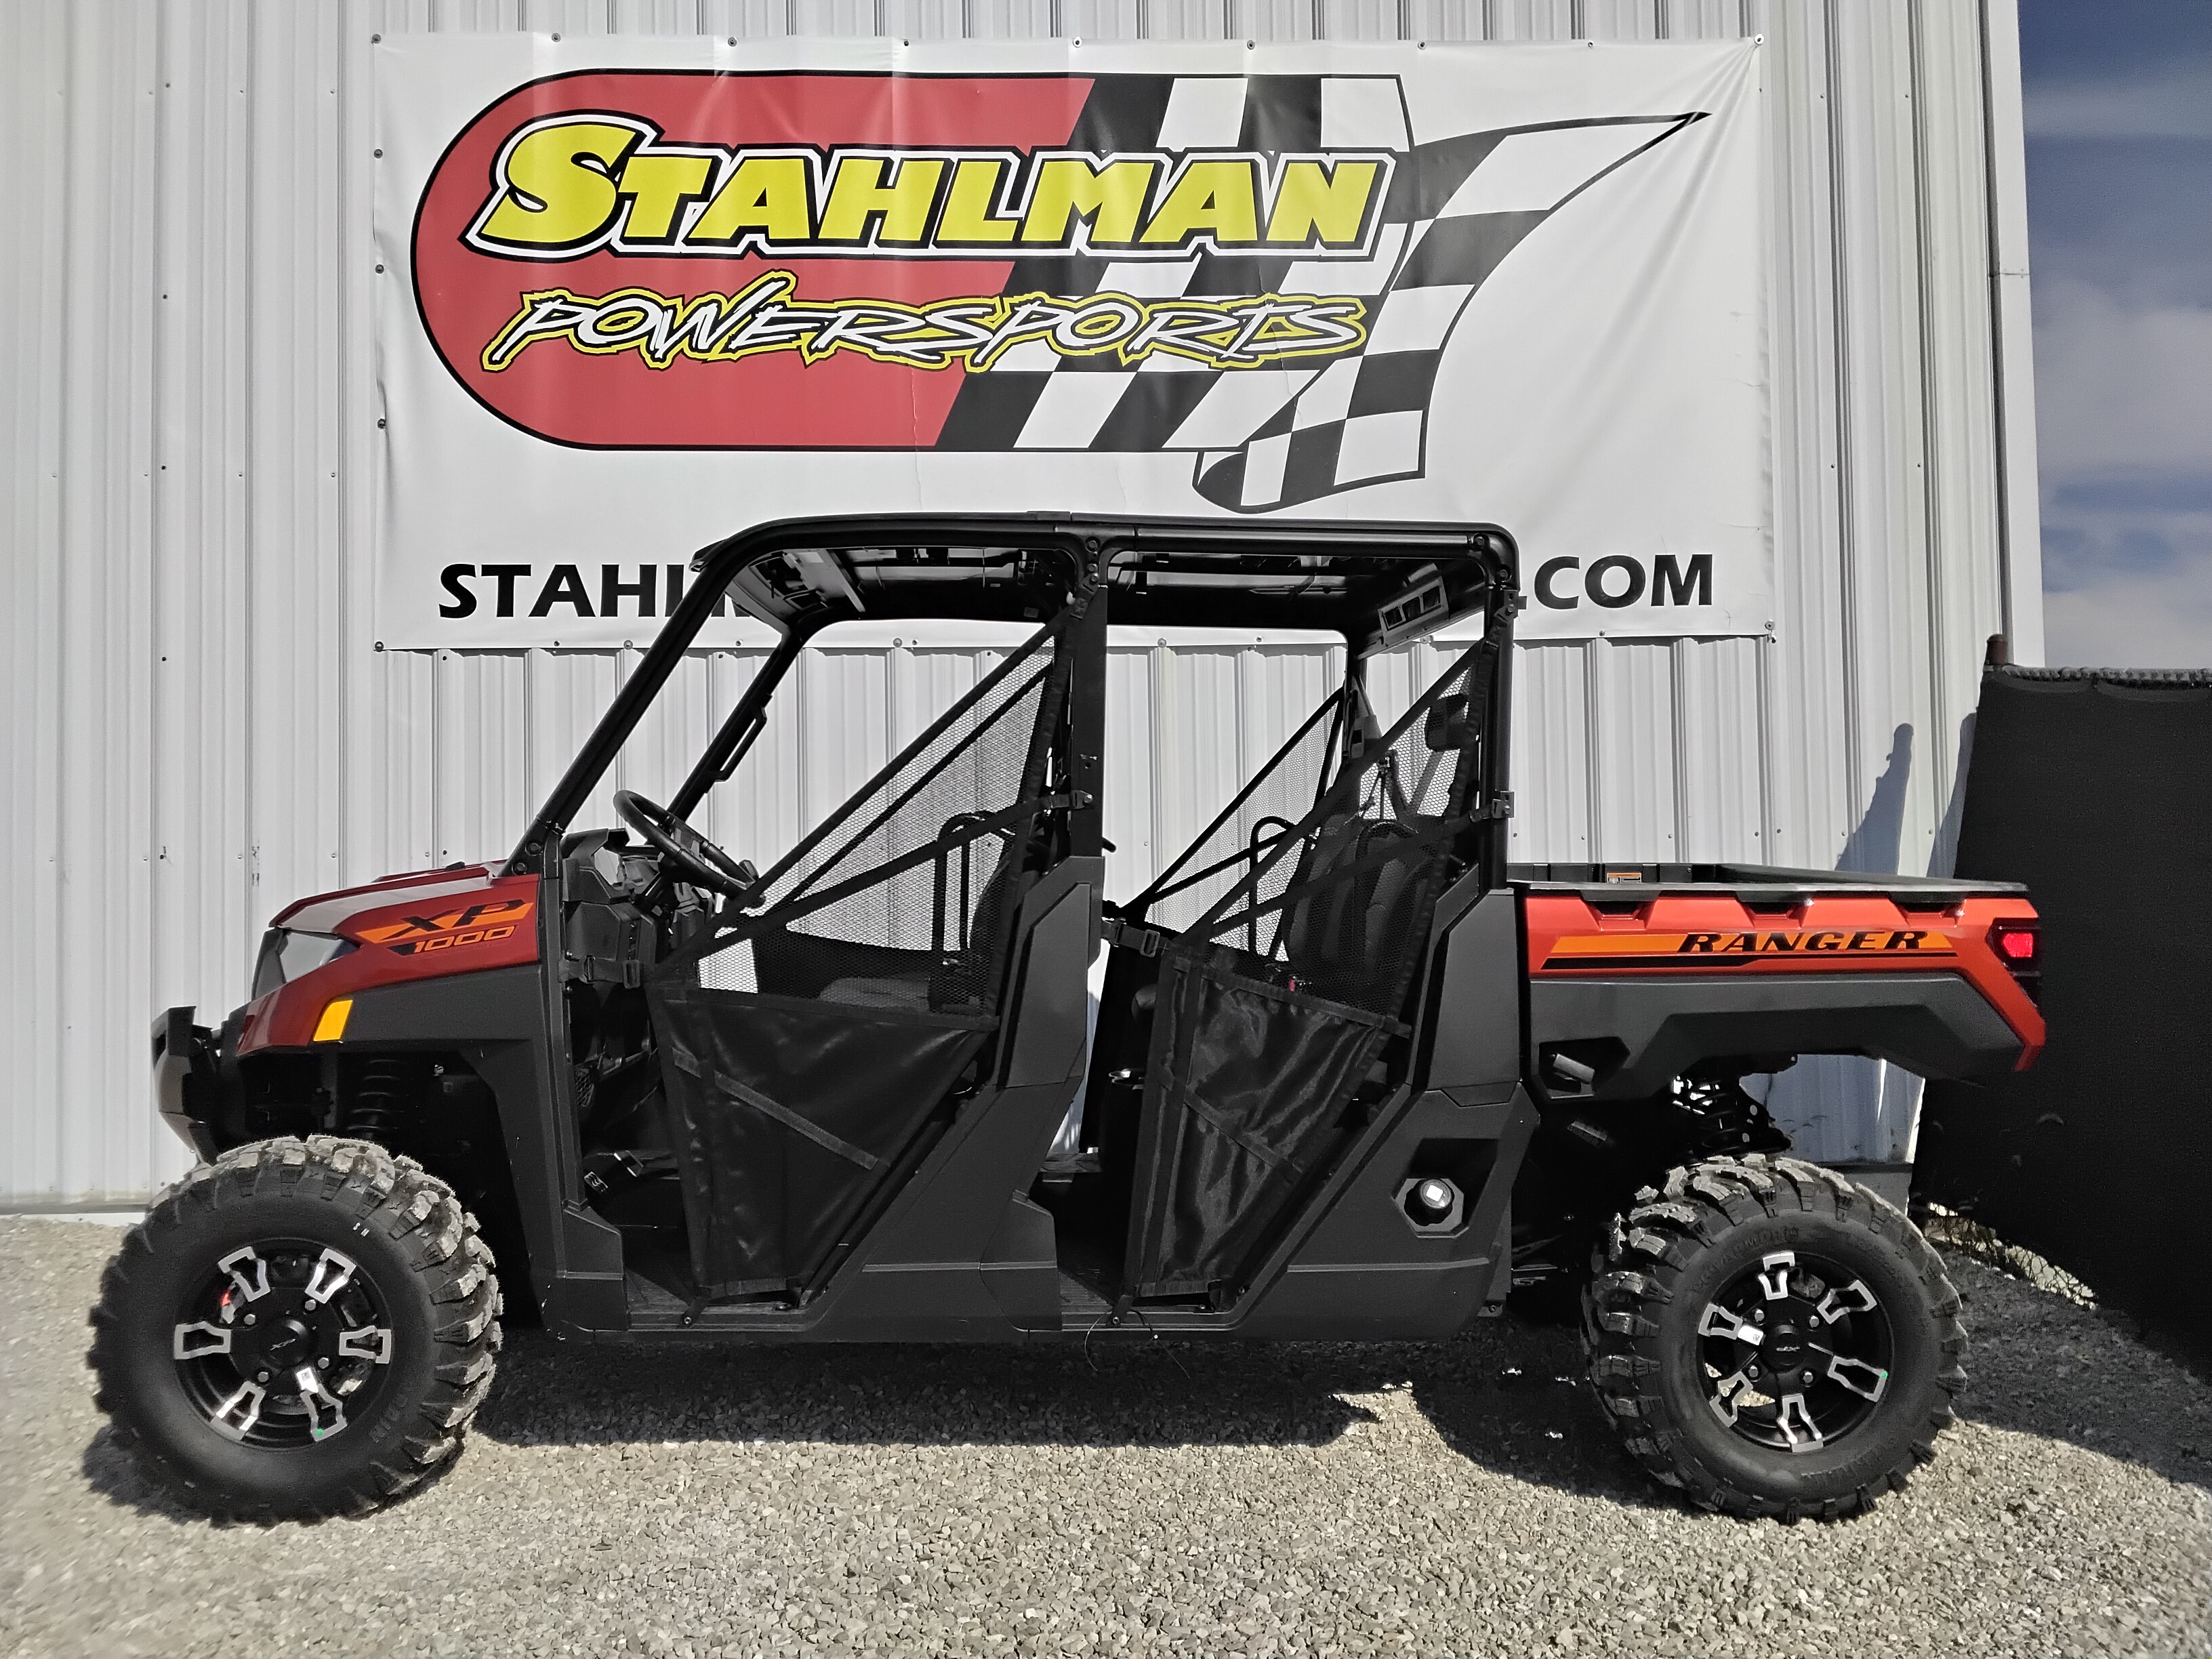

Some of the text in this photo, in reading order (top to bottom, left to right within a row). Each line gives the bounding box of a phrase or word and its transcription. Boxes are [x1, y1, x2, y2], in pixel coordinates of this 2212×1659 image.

[462, 111, 1395, 262] STAHLMAN
[480, 270, 1365, 371] POWERSPORTS
[380, 899, 527, 941] XP
[413, 926, 516, 954] 1000
[1677, 930, 1928, 953] RANGER
